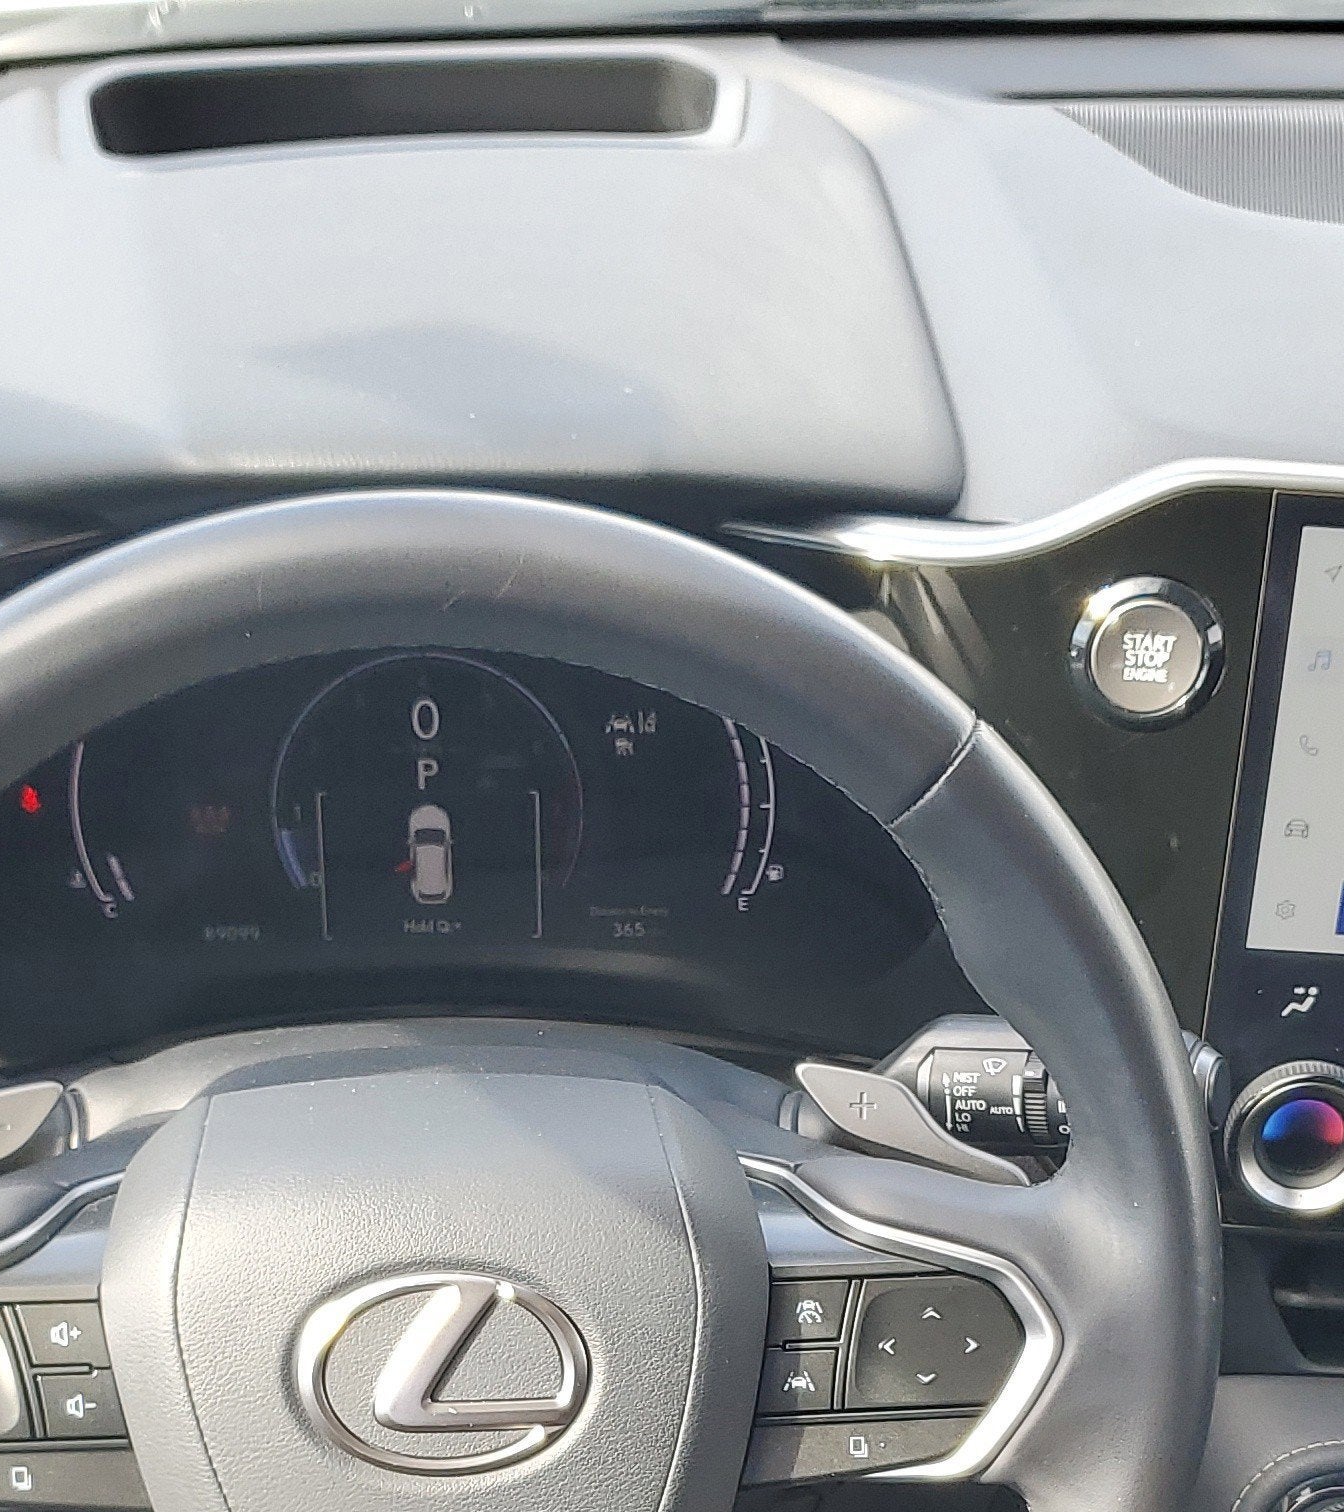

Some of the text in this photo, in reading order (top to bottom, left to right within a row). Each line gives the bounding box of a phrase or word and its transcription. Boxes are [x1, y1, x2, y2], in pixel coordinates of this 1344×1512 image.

[1122, 632, 1178, 653] START
[1124, 650, 1170, 668] STOP
[1122, 667, 1168, 683] ENGINE
[412, 700, 439, 740] 0
[418, 759, 439, 790] P
[738, 897, 749, 911] E
[952, 1072, 981, 1083] MIST
[953, 1086, 977, 1097] OFF
[955, 1100, 987, 1111] AUTO
[989, 1107, 1014, 1115] AUTO
[955, 1113, 971, 1122] LO
